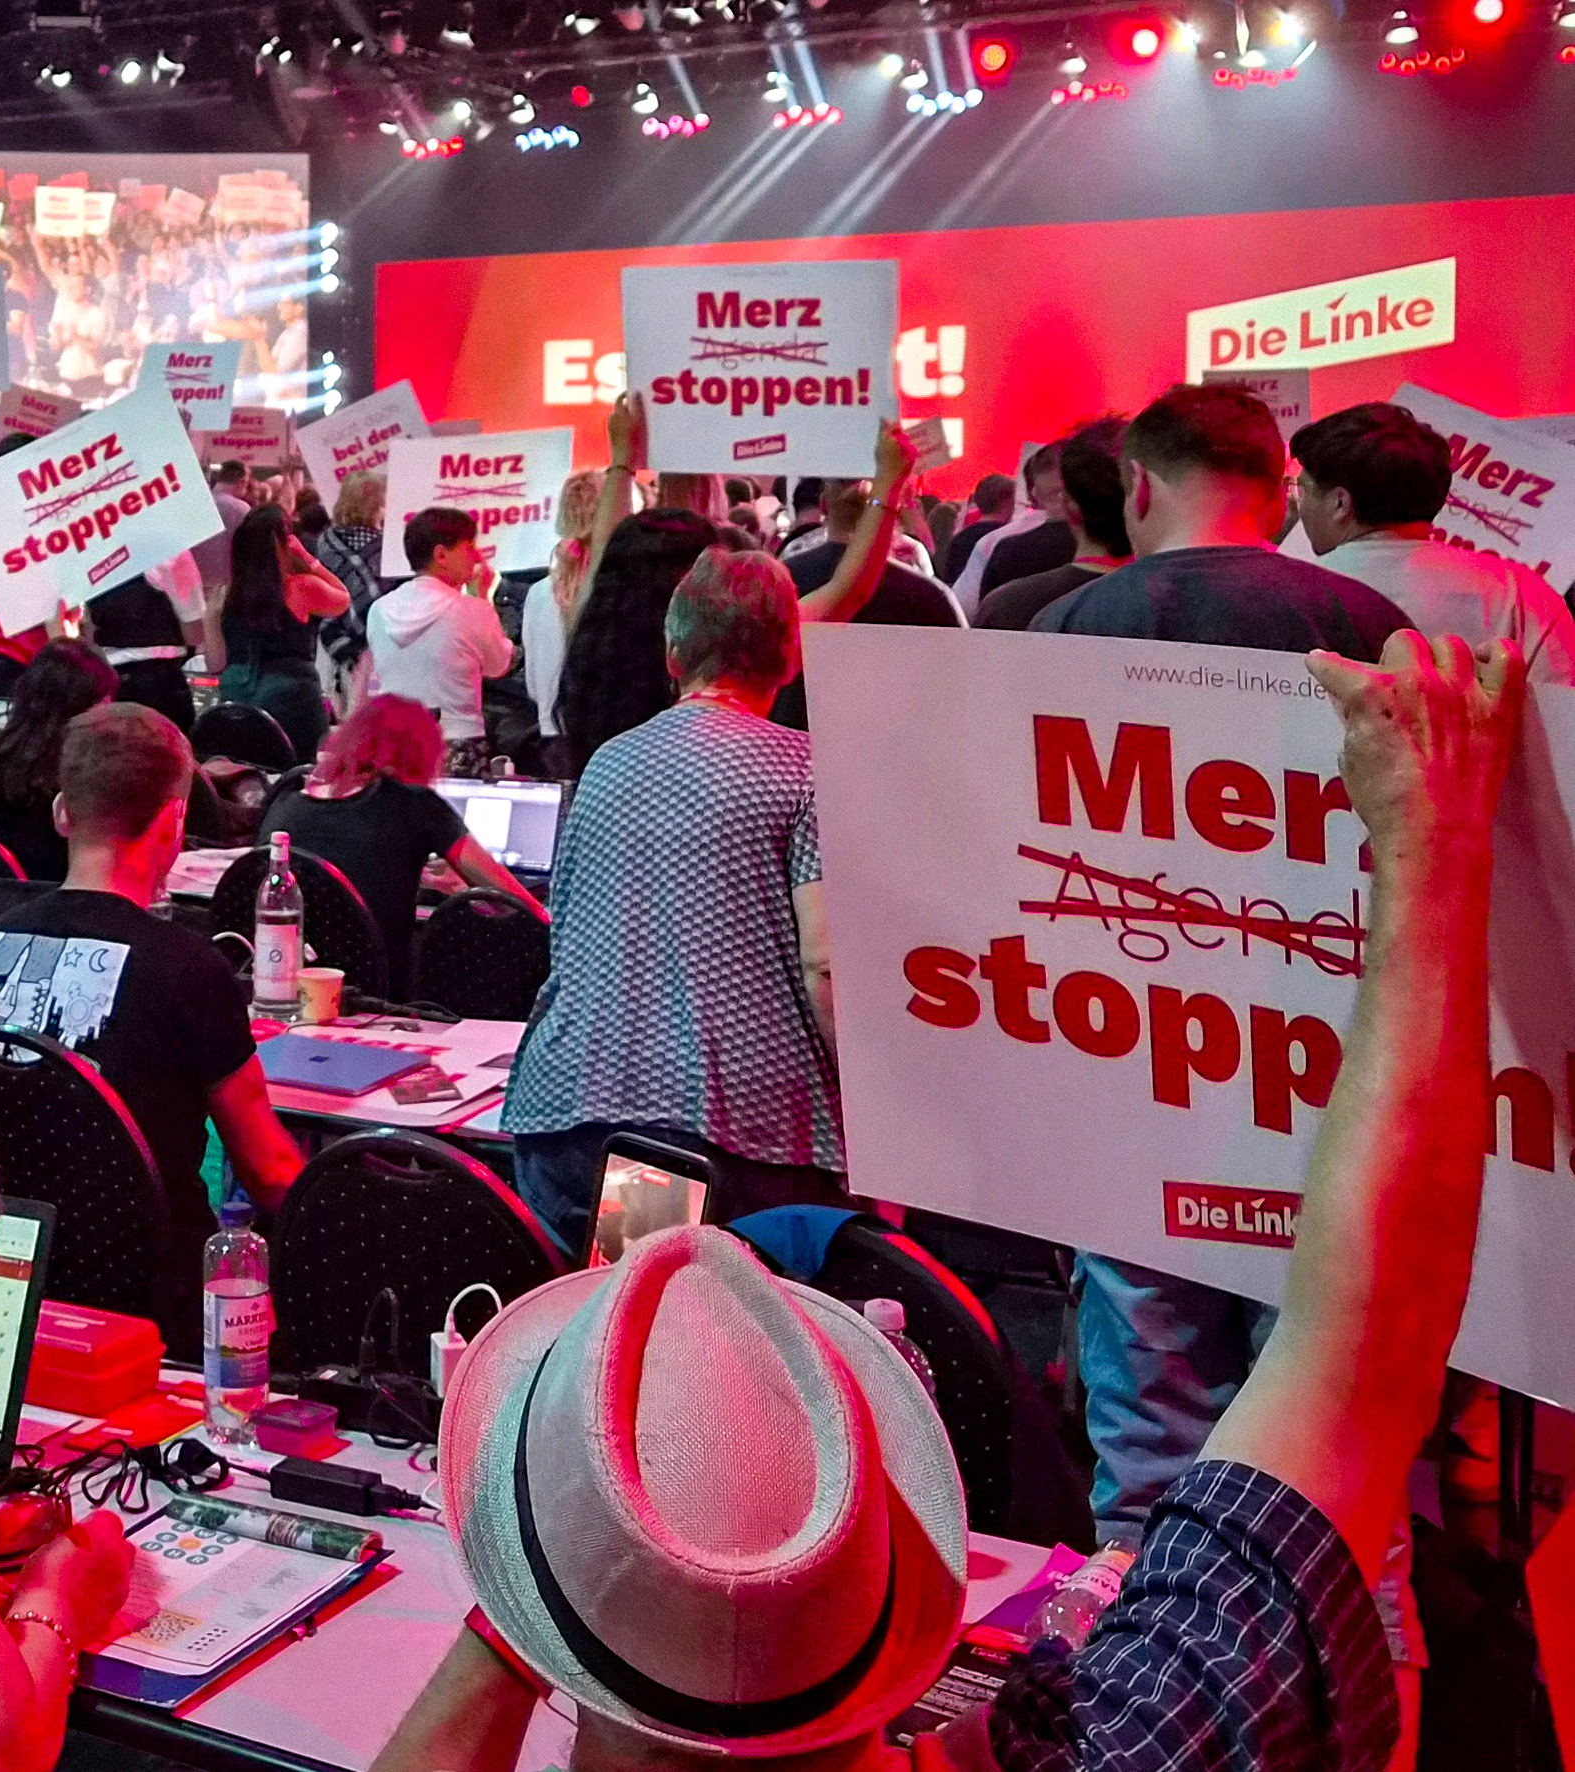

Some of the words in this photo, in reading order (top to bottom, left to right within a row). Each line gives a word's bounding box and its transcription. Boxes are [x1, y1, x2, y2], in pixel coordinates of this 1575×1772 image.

[696, 291, 823, 328] Merz
[1210, 320, 1287, 367] Die
[1300, 290, 1435, 350] Linke
[166, 353, 214, 368] Merz
[651, 368, 871, 417] stoppen!
[17, 432, 123, 500] Merz
[332, 437, 364, 462] bei
[367, 422, 402, 446] den
[439, 453, 524, 479] Merz
[1449, 433, 1556, 508] Merz
[2, 462, 182, 574] stoppen!
[1124, 664, 1327, 700] www.die-linke.de
[1033, 714, 1373, 872] Mer
[1049, 852, 1363, 978] Agend
[902, 935, 1575, 1174] stoppn
[1177, 1196, 1229, 1230] Die
[1234, 1197, 1298, 1238] Link
